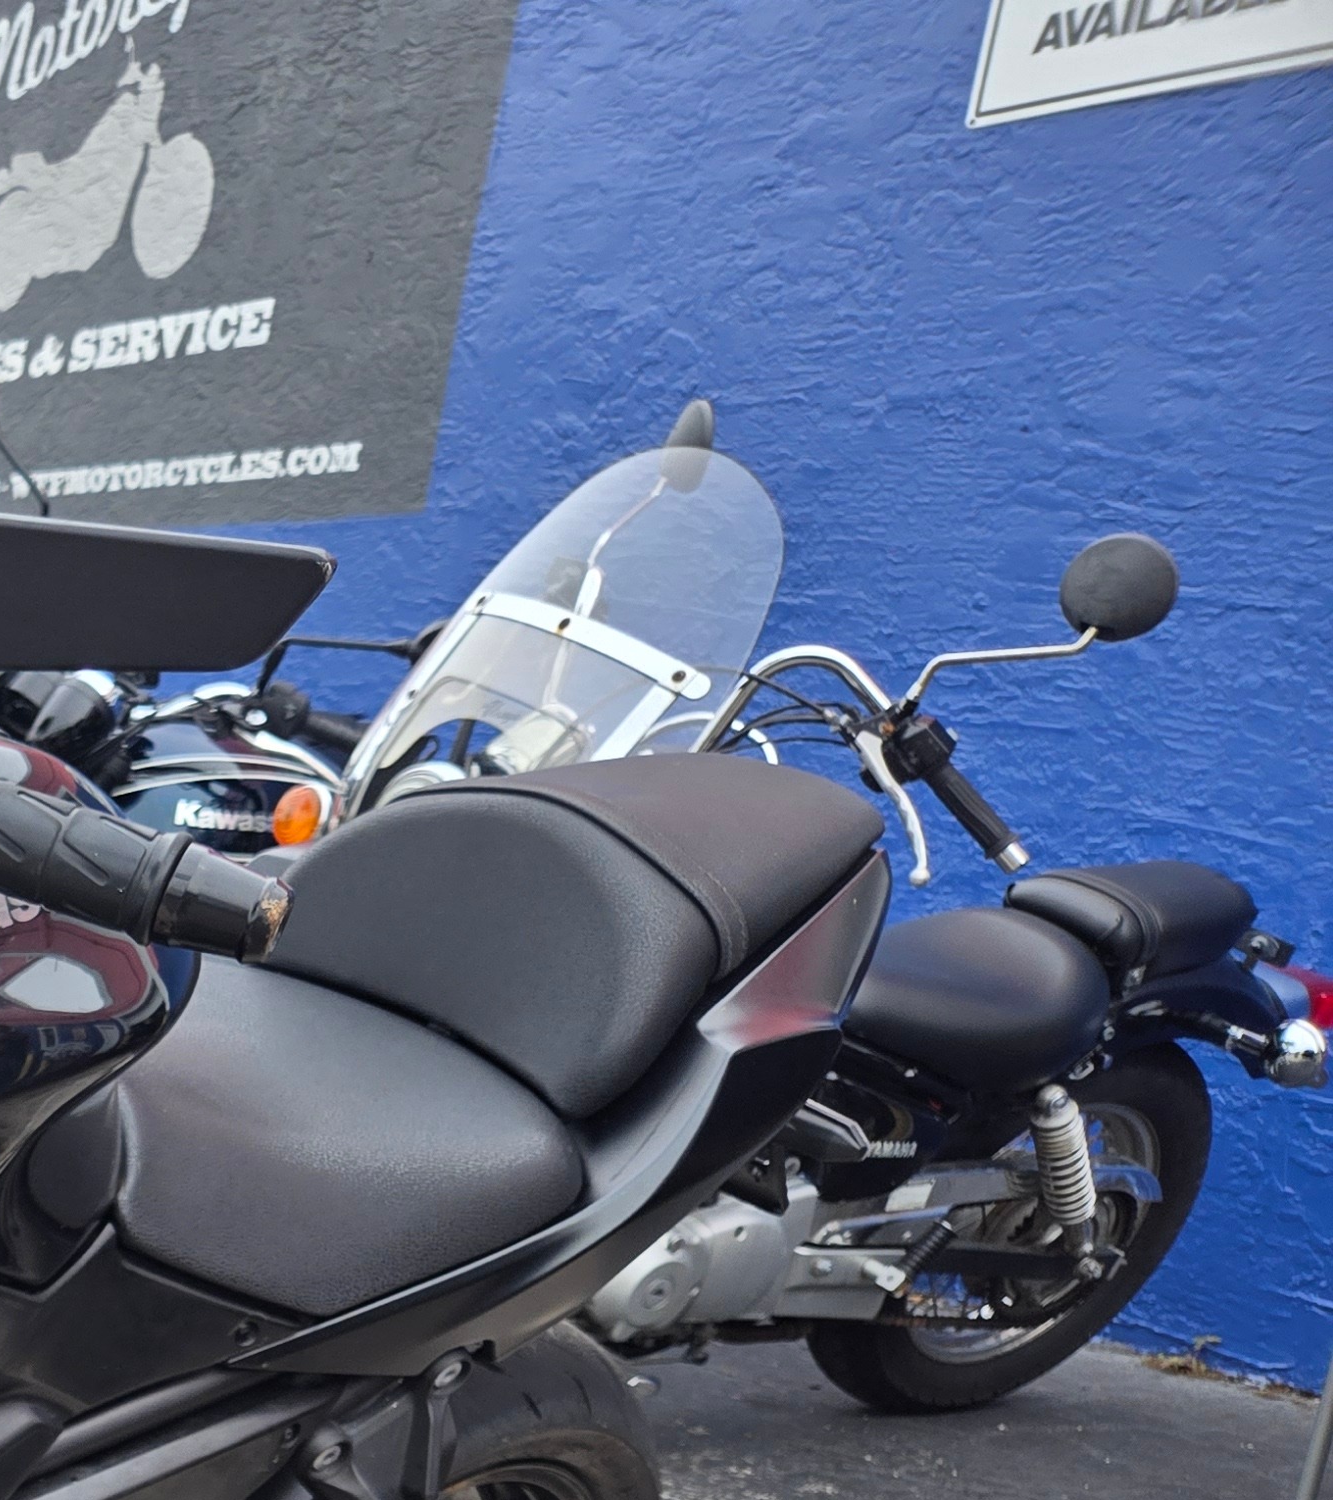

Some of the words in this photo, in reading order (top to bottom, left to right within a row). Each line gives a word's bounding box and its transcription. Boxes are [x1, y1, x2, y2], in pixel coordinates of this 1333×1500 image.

[1032, 0, 1289, 54] AVAILA
[29, 335, 65, 379] &
[68, 297, 276, 373] SERVICE
[173, 797, 273, 833] Kawas
